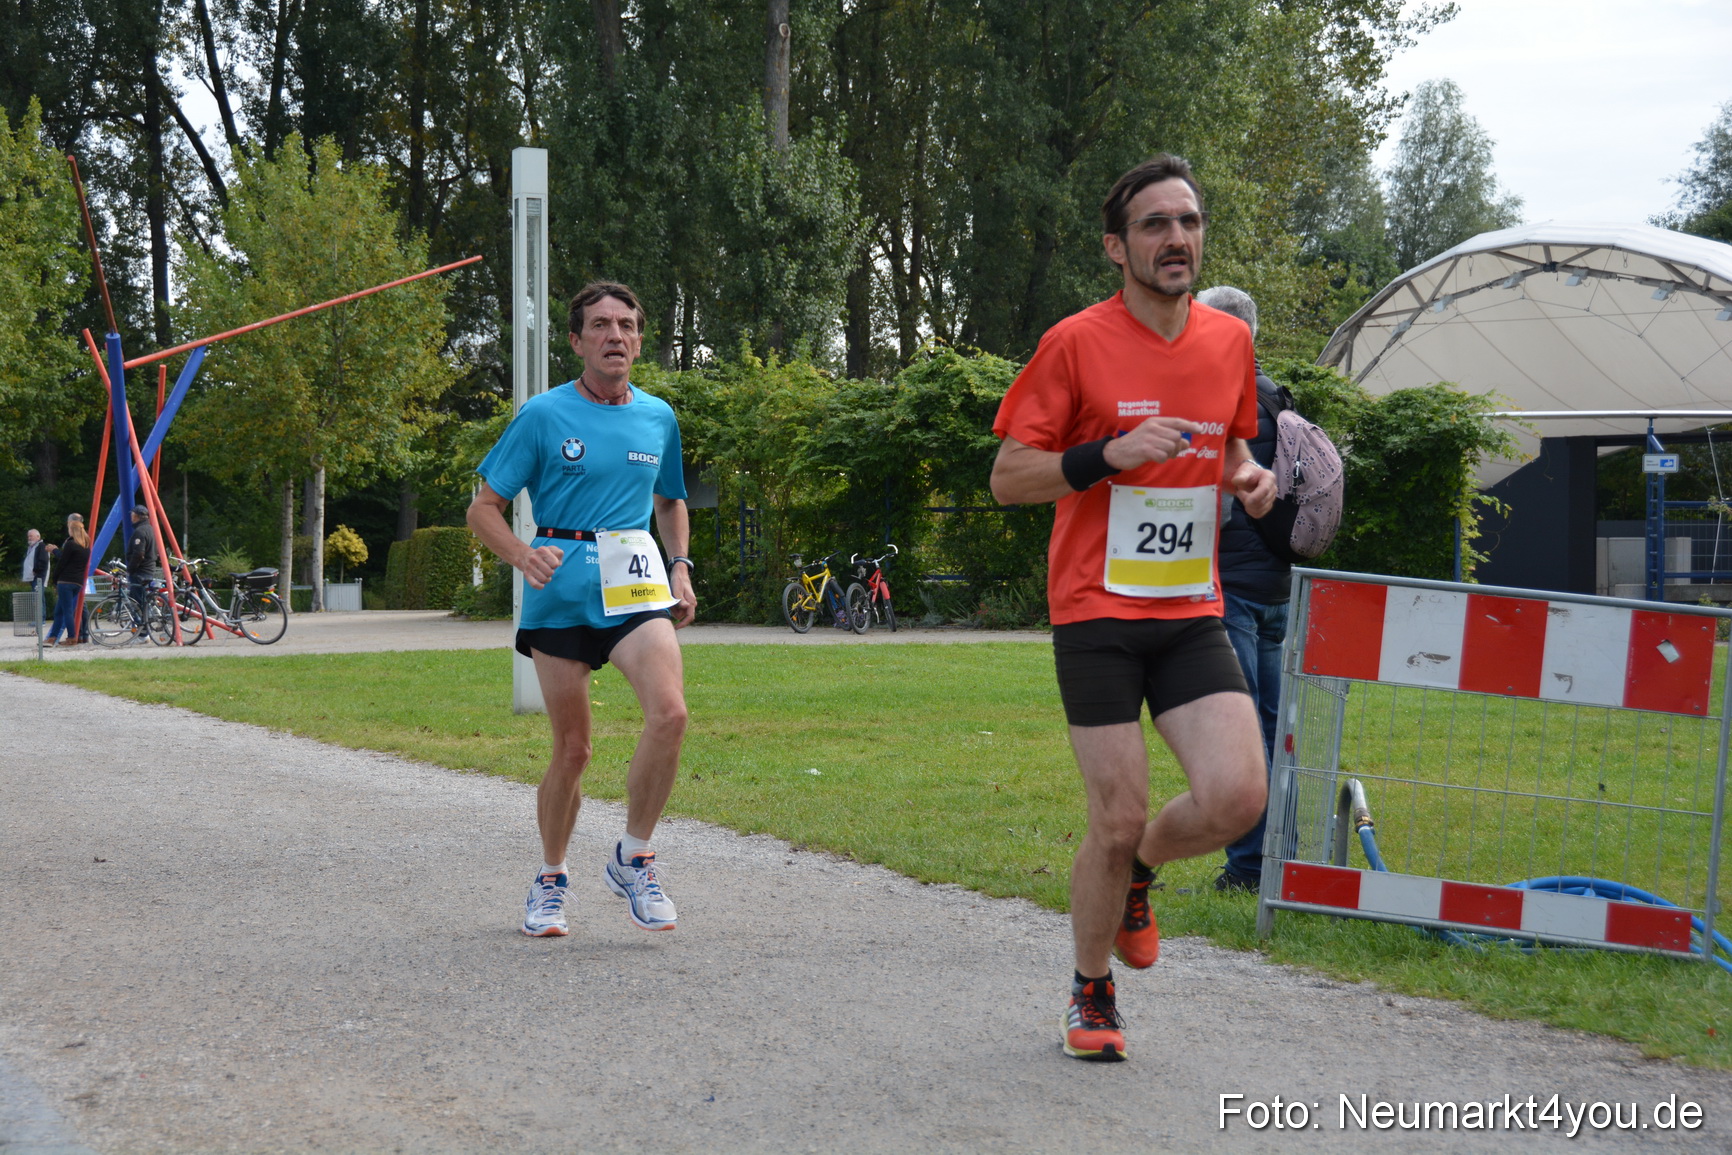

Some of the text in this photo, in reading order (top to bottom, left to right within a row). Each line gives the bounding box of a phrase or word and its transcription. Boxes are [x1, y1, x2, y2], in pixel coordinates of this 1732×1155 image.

[1117, 400, 1160, 409] Regensburg
[1118, 407, 1159, 417] Marathon
[1193, 421, 1224, 435] 006
[628, 451, 659, 465] BOCK
[1157, 498, 1193, 508] BOCK
[1136, 522, 1194, 555] 294
[628, 554, 651, 578] 42
